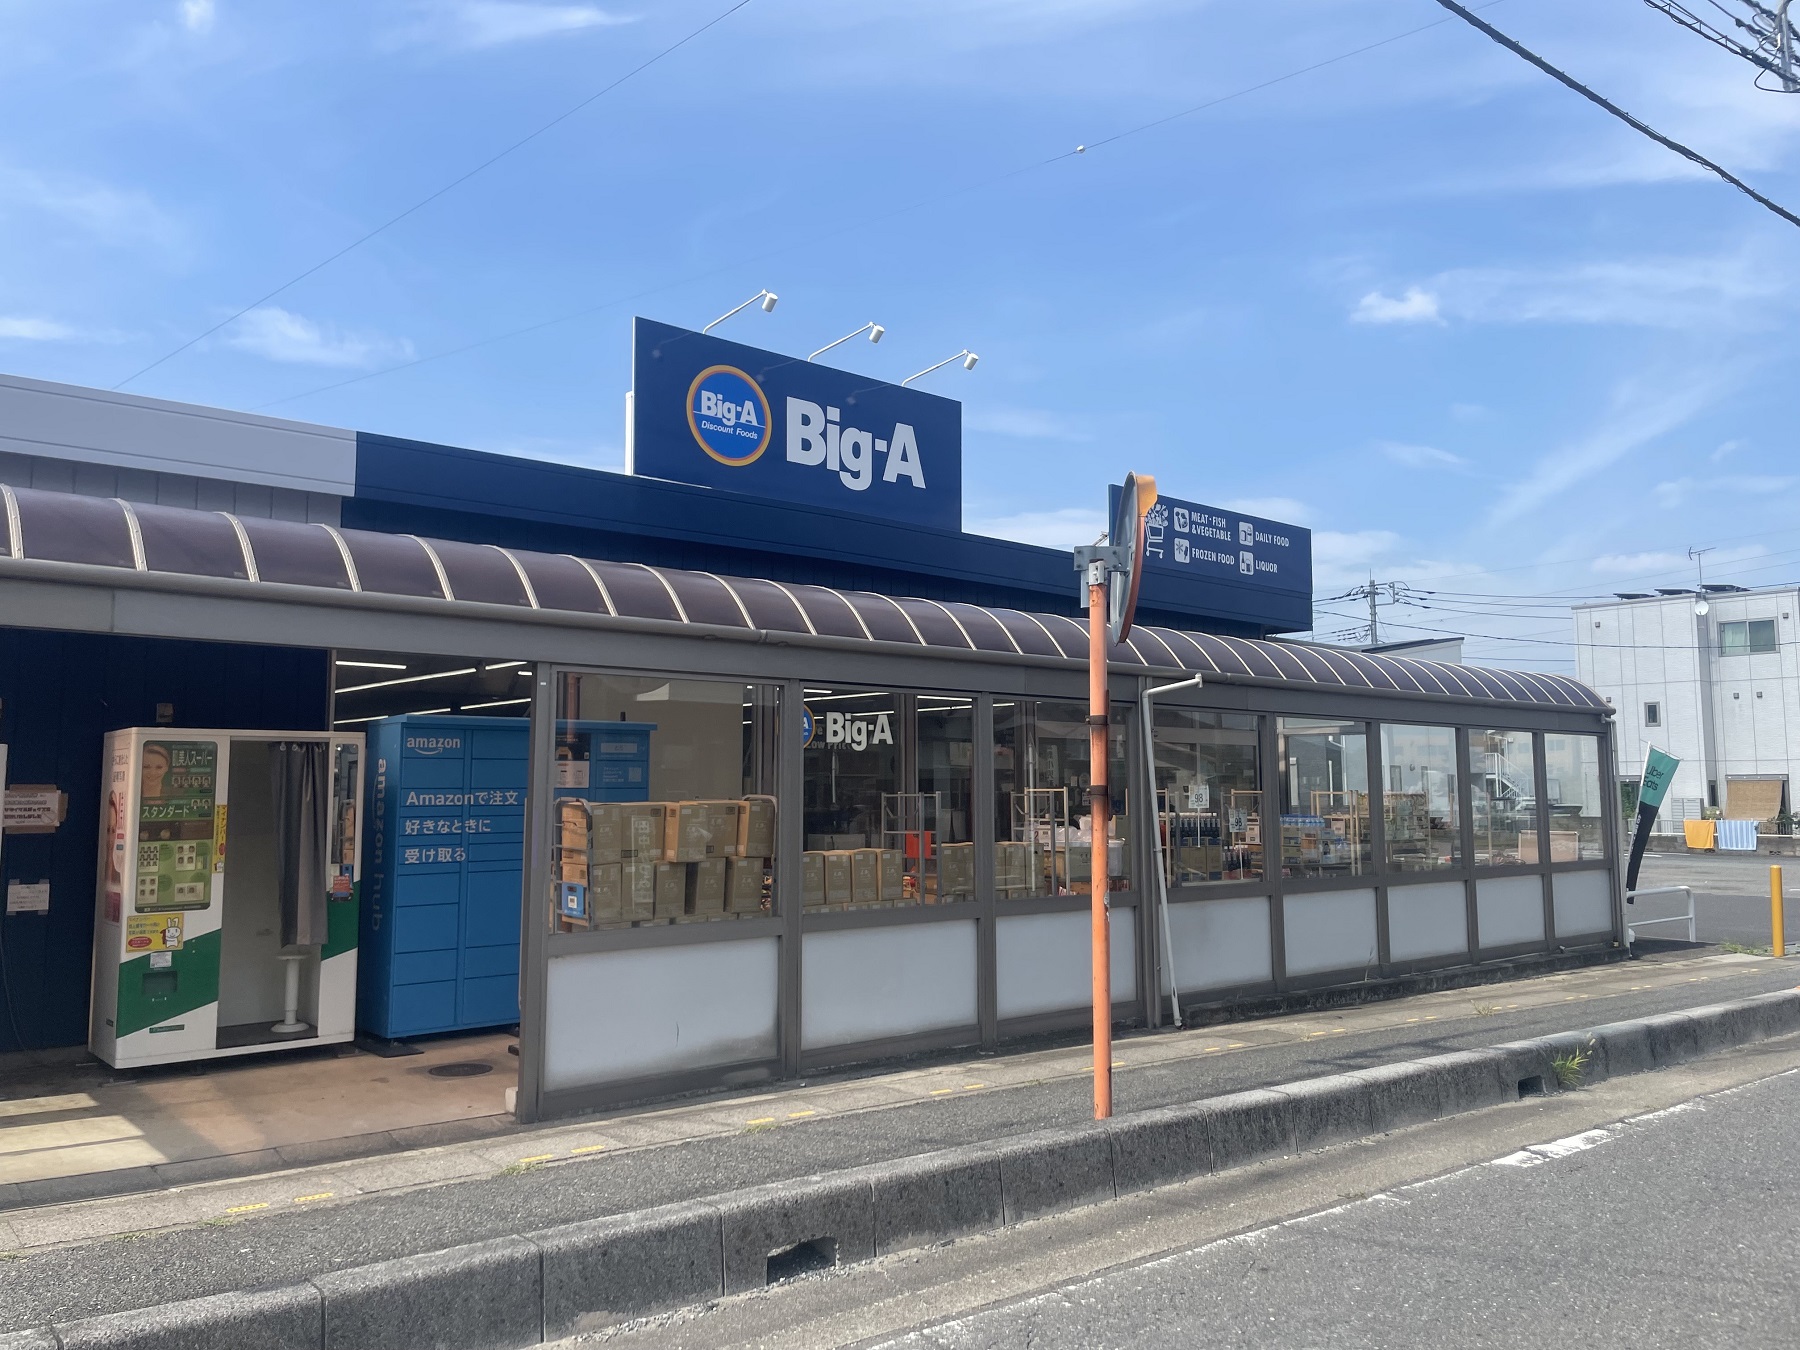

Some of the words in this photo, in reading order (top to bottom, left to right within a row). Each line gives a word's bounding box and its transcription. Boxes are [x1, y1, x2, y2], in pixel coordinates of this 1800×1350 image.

[701, 390, 758, 425] Big-A
[701, 420, 734, 435] Discount
[736, 428, 759, 440] Foods
[786, 396, 926, 491] Big-A
[1191, 524, 1231, 541] &VEGETABLE
[1255, 531, 1272, 544] DAILY
[1273, 535, 1289, 547] FOOD
[1191, 547, 1217, 562] FROZEN
[1217, 553, 1235, 565] FOOD
[1255, 560, 1278, 574] LIQUOR
[826, 711, 894, 752] Big-A
[407, 736, 461, 749] amazon
[1646, 764, 1665, 780] Uber
[1643, 777, 1659, 791] Eats
[406, 790, 519, 806] Amazonで注文
[142, 804, 190, 818] スタンダード
[374, 758, 387, 865] amazon
[404, 818, 492, 835] 好きなときに
[404, 847, 467, 864] 受け取る
[371, 872, 385, 931] hub
